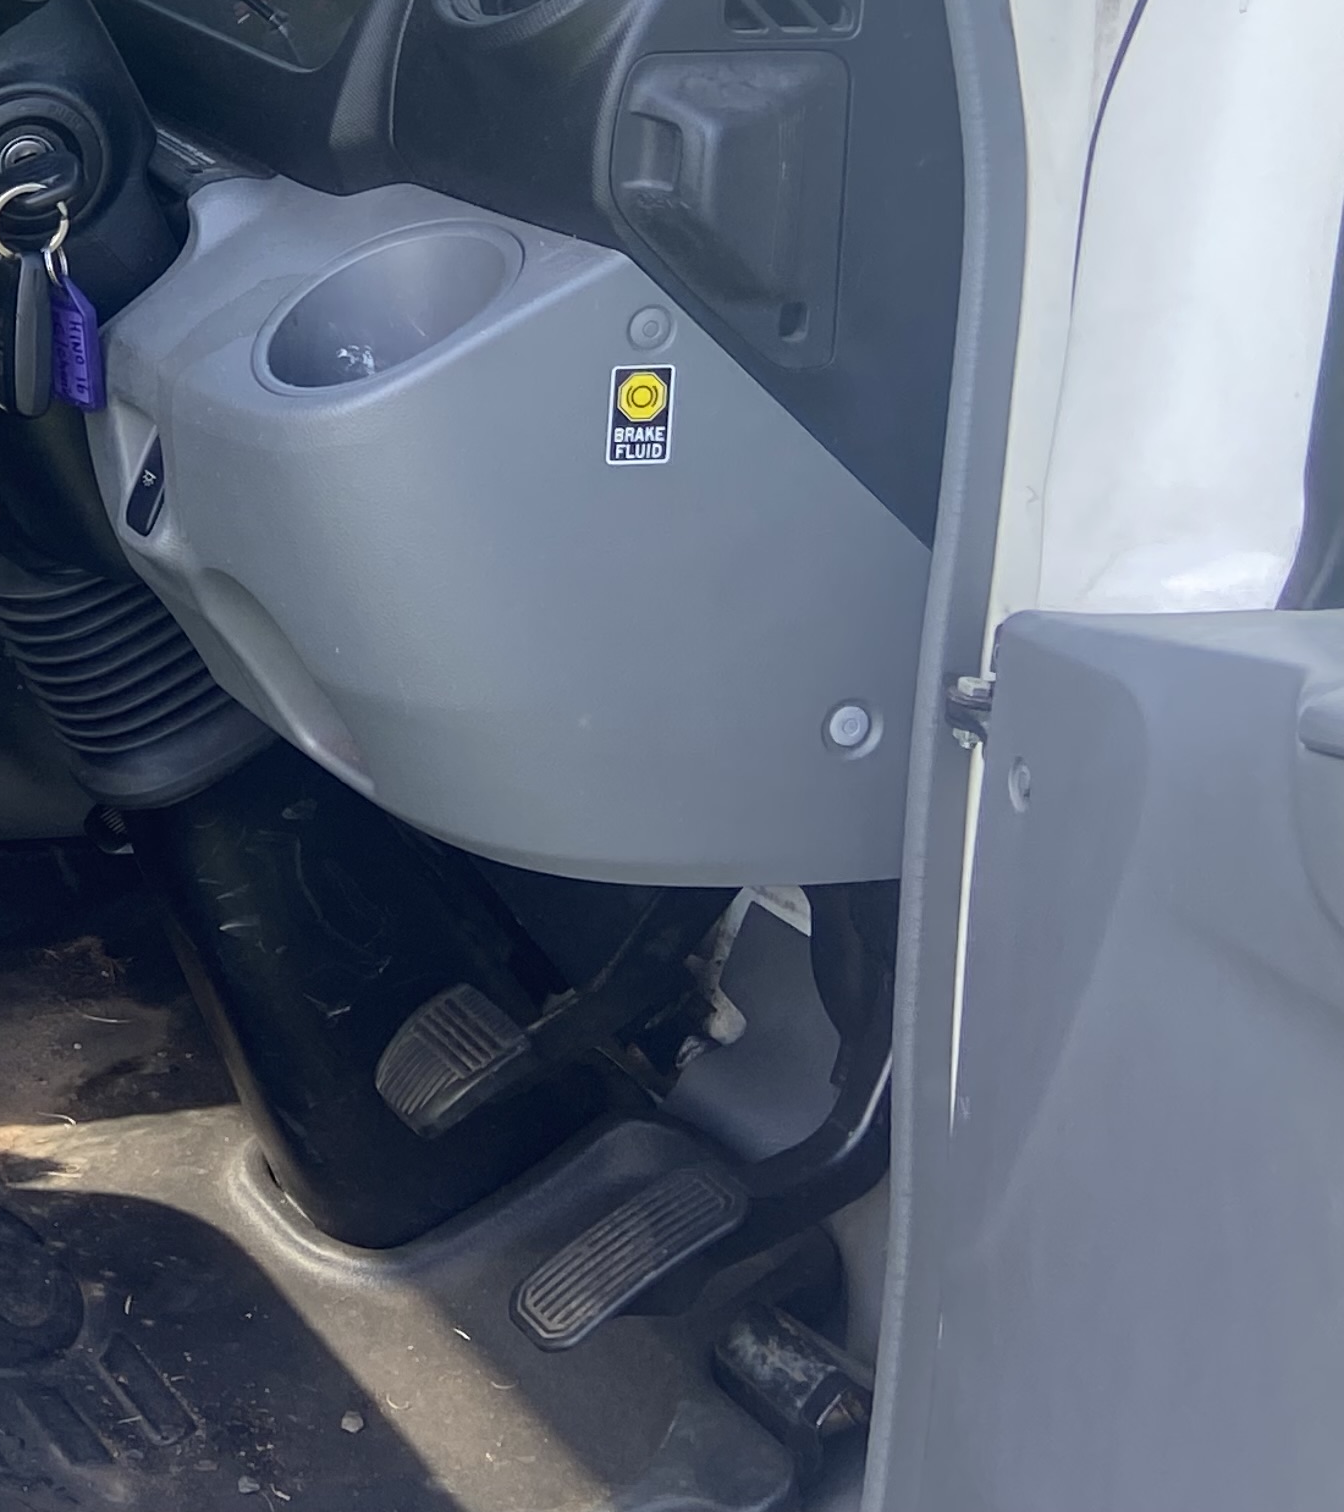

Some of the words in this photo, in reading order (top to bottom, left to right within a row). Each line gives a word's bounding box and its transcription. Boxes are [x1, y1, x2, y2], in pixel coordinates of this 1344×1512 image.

[69, 320, 85, 365] HINO
[614, 426, 666, 443] BRAKE
[615, 443, 663, 459] FLUID
